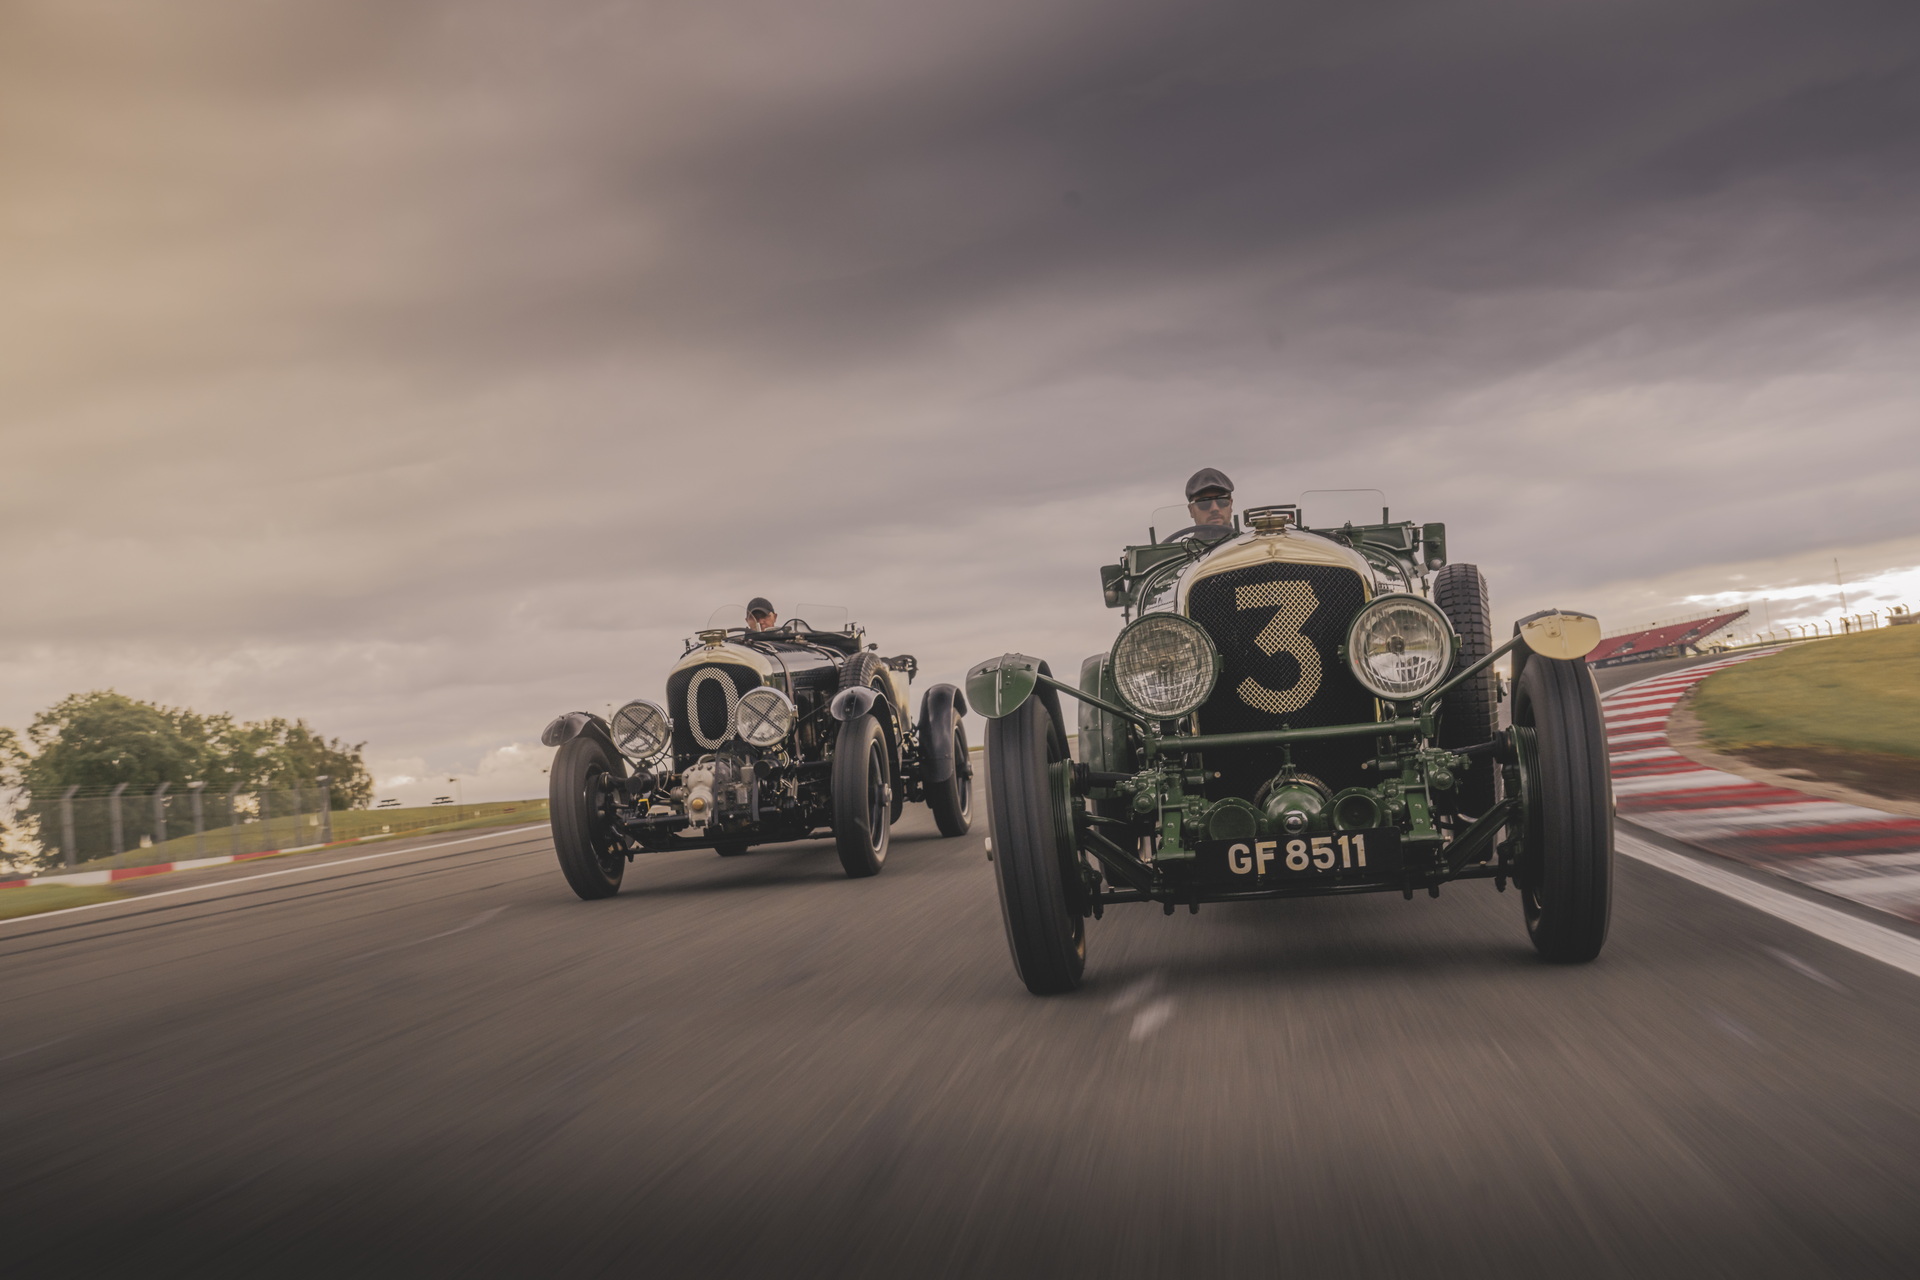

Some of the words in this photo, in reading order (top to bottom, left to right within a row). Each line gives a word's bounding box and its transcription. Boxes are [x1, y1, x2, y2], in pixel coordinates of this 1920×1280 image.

[1235, 580, 1323, 714] 3
[1228, 841, 1277, 875] GF
[1285, 834, 1366, 871] 8511
